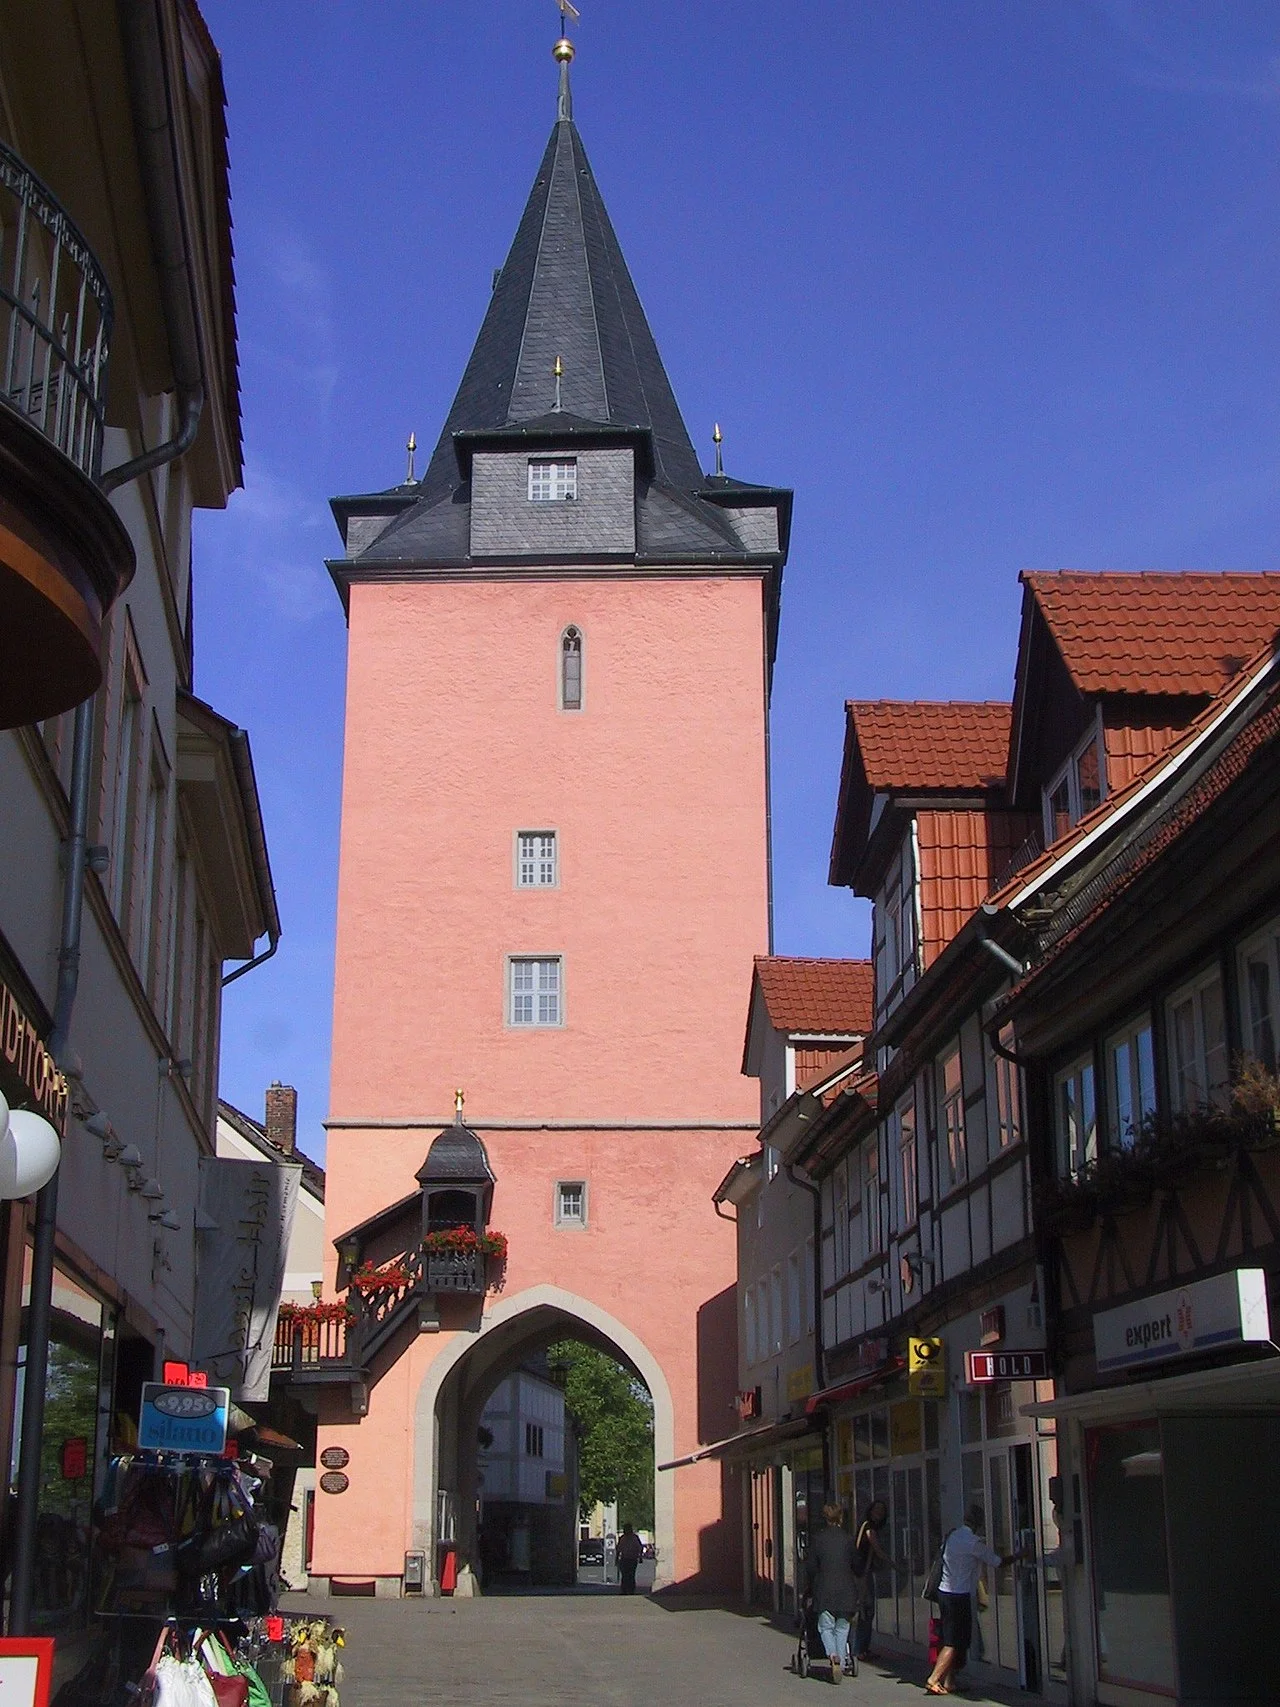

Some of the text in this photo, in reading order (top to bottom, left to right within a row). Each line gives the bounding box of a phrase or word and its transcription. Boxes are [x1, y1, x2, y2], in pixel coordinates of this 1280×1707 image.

[236, 1171, 271, 1245] Hair
[1125, 1314, 1172, 1348] expert
[985, 1356, 1032, 1377] HOLD
